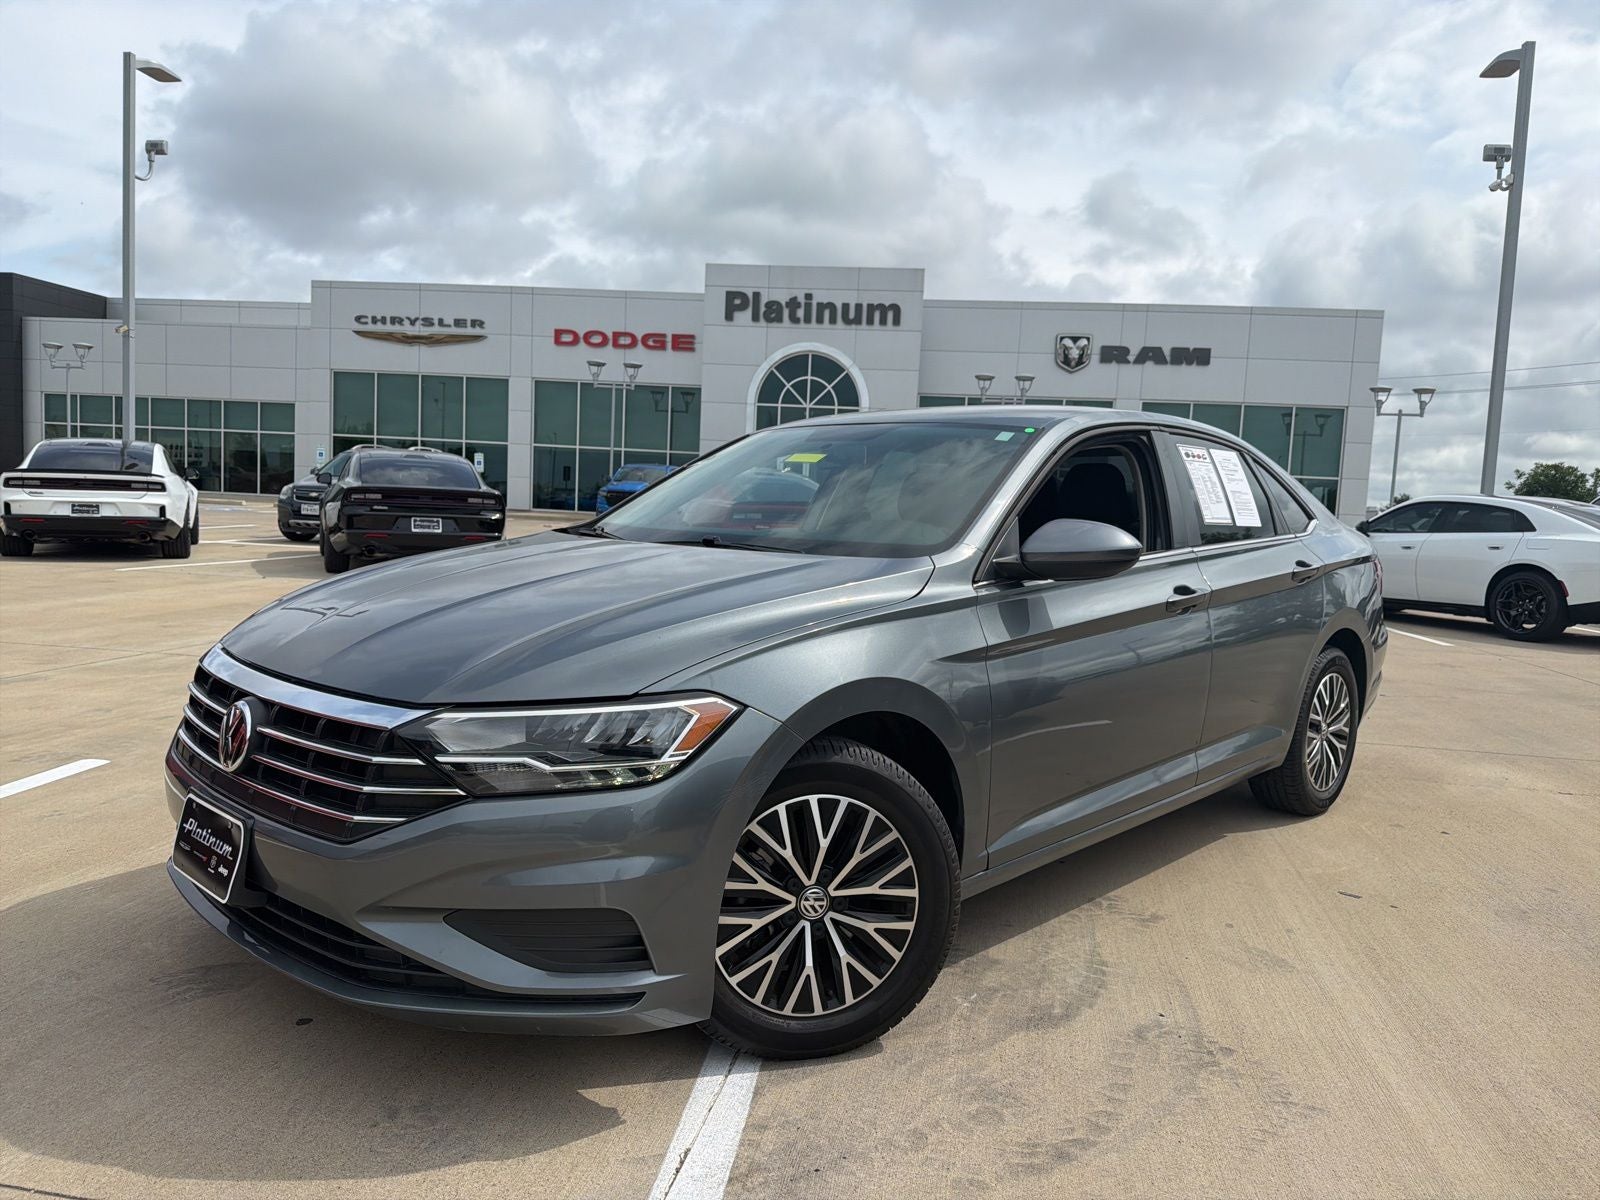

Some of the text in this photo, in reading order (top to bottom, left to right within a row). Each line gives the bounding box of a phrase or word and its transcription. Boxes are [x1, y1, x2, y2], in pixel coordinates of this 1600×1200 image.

[724, 290, 902, 327] Platinum
[354, 314, 486, 329] CHRYSLER
[554, 328, 696, 352] DODGE
[1099, 345, 1212, 366] RAM
[183, 817, 233, 860] Platinum
